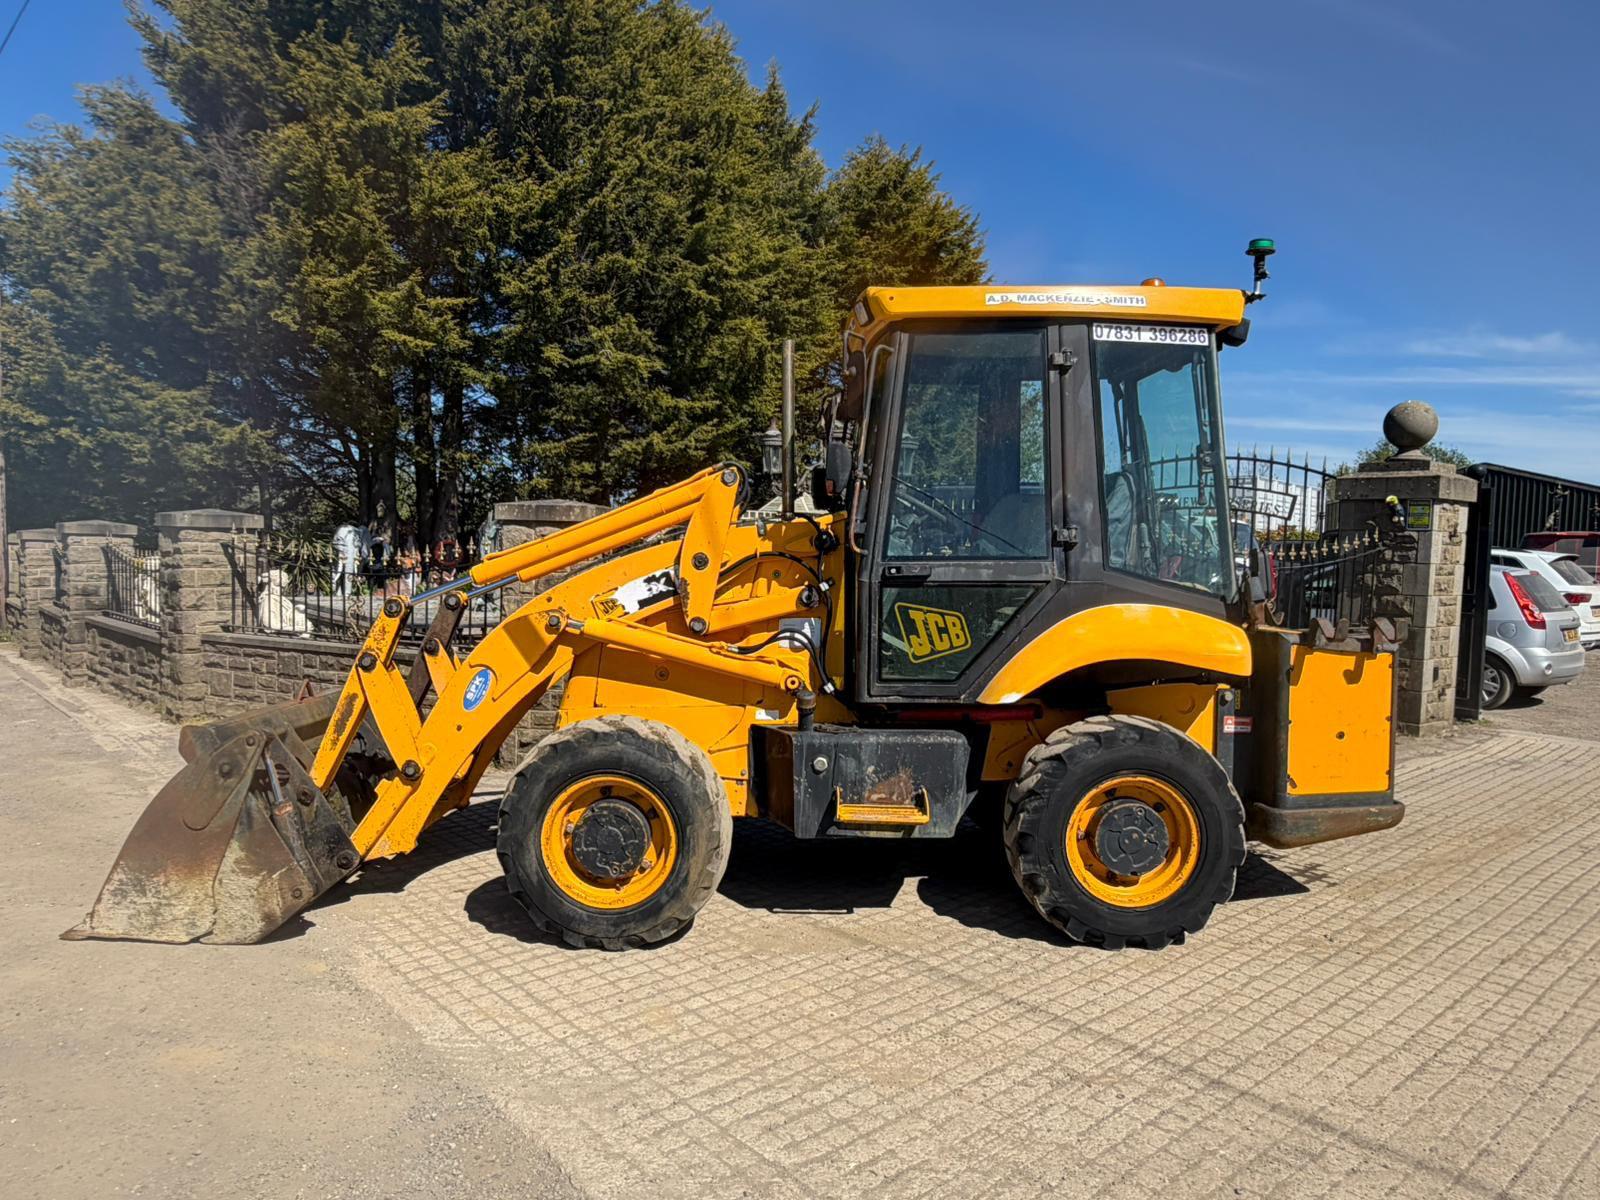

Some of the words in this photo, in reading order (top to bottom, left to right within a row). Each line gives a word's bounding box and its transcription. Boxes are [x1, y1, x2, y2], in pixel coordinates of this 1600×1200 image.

[1095, 324, 1142, 341] 07831
[1149, 327, 1207, 344] 396286
[909, 609, 966, 656] JCB
